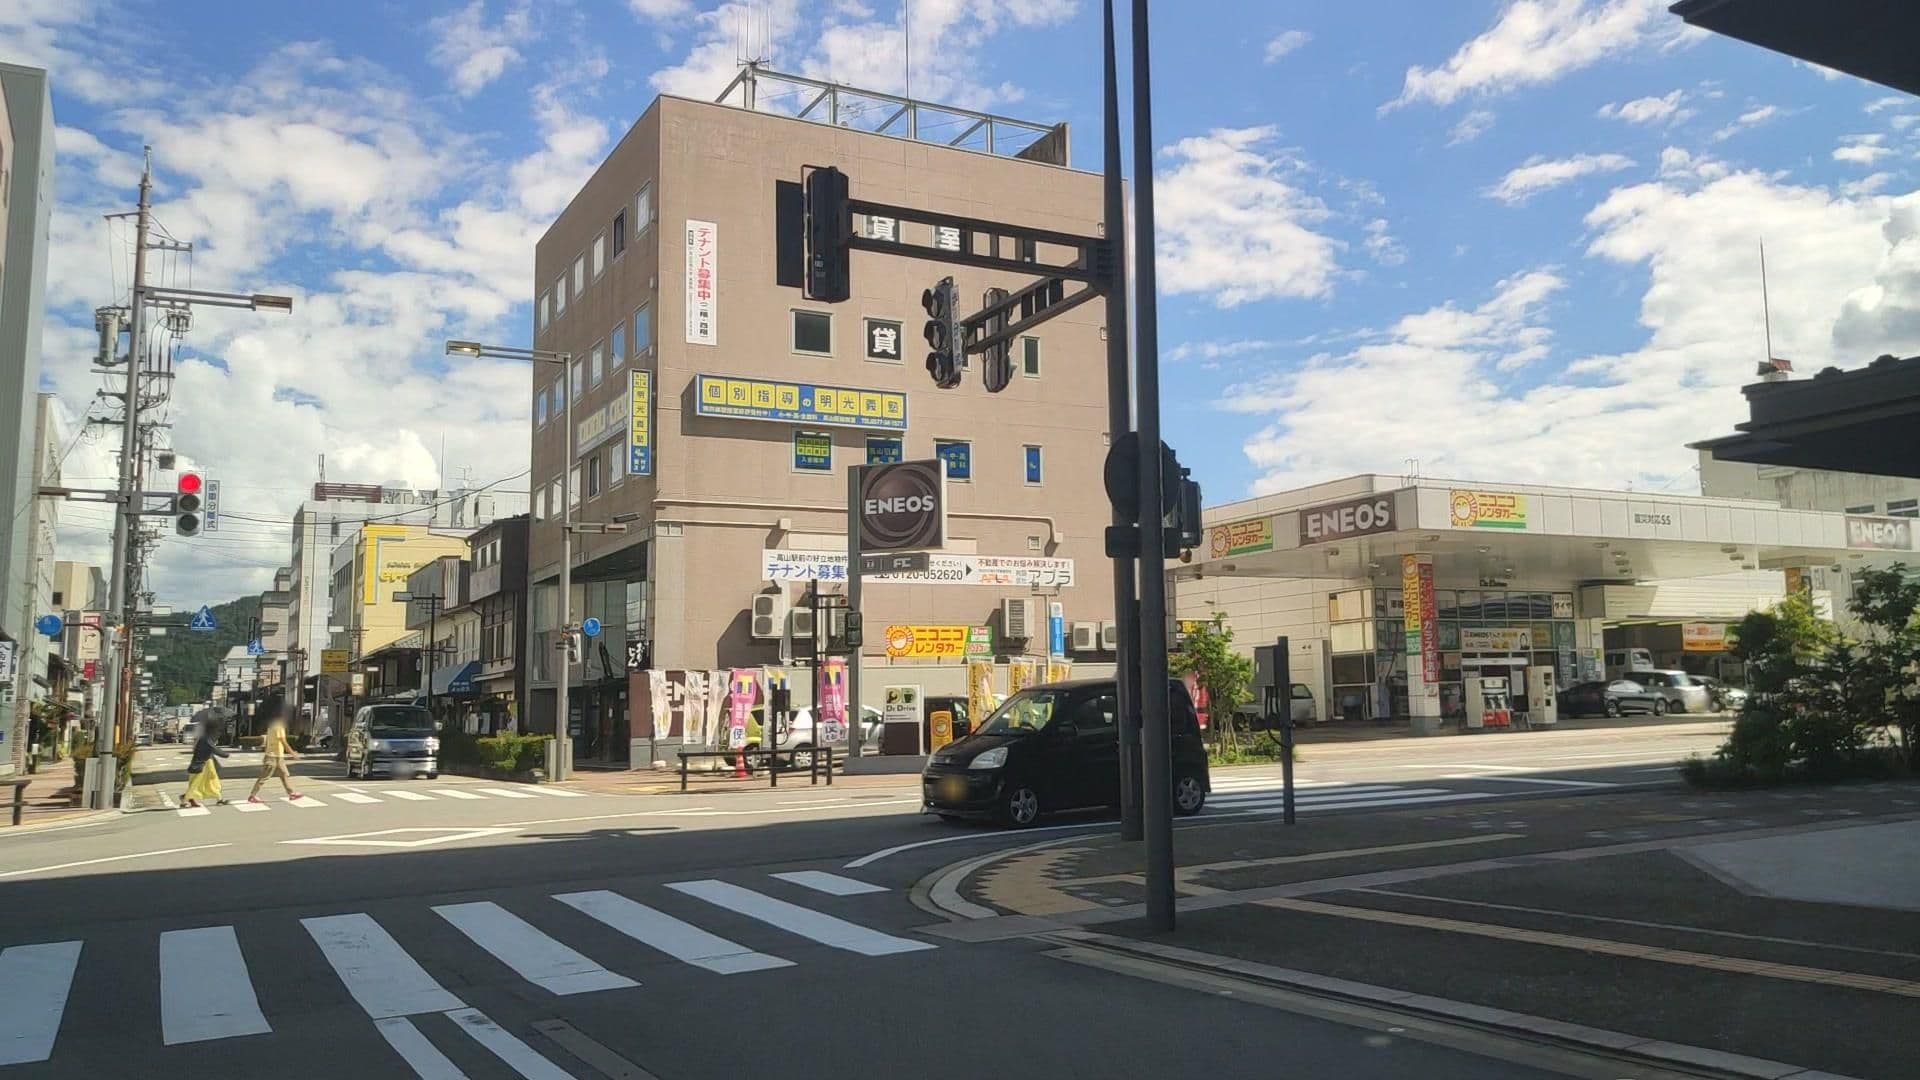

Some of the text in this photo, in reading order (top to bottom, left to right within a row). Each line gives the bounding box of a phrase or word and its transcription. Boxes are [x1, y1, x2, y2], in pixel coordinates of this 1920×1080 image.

[872, 327, 897, 355] 貸
[864, 494, 935, 516] ENEOS
[1479, 494, 1515, 508] ニコニコ
[1307, 500, 1390, 538] ENEOS
[1479, 507, 1517, 518] レンタカー
[1231, 521, 1263, 533] ニコニコ
[1231, 533, 1265, 546] レンタカー
[768, 563, 848, 580] テナント募集
[915, 629, 964, 641] ニコニコ
[915, 642, 963, 654] レンタカー
